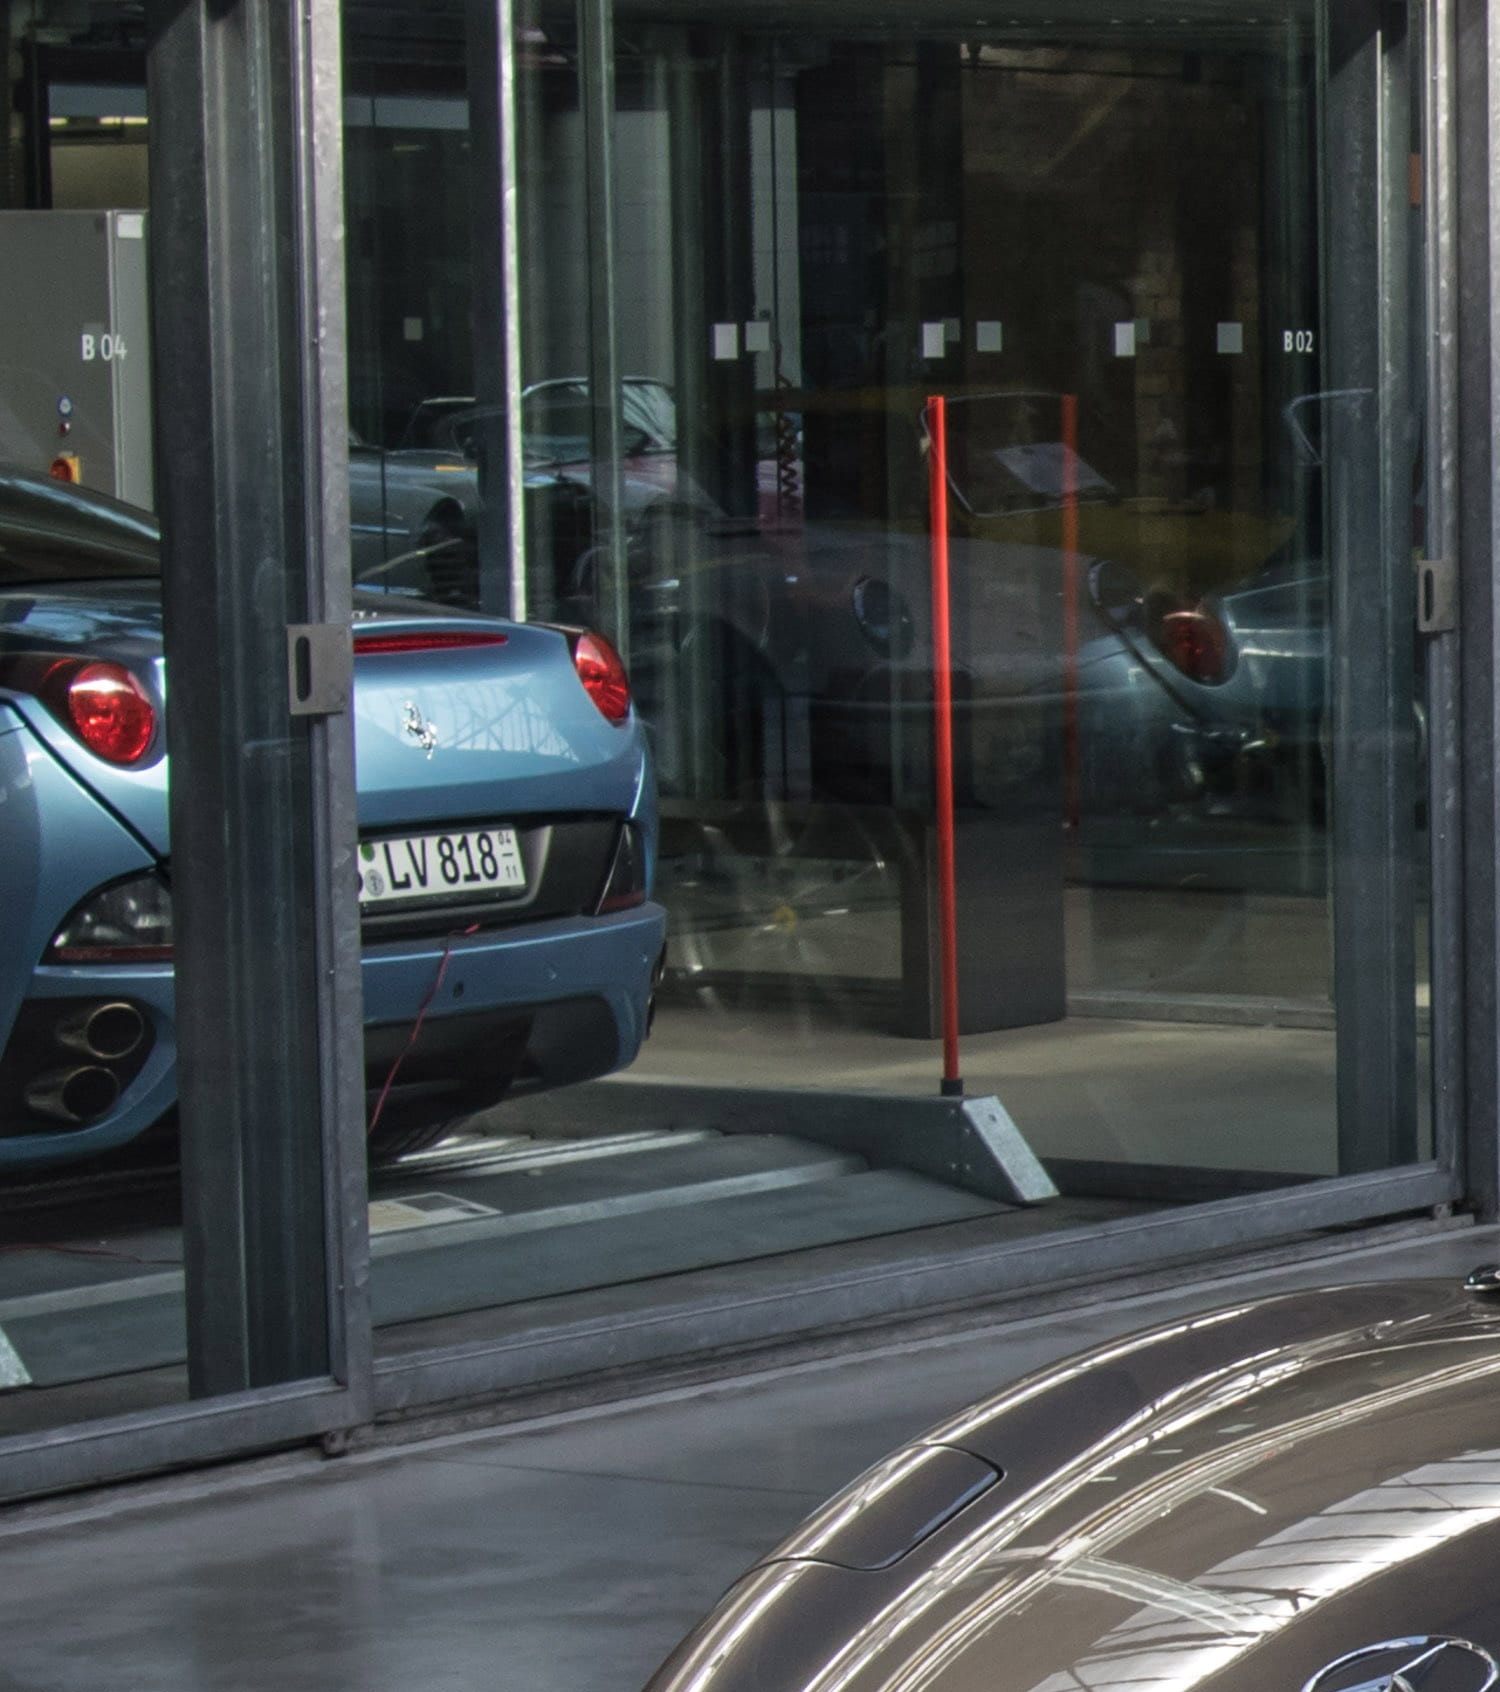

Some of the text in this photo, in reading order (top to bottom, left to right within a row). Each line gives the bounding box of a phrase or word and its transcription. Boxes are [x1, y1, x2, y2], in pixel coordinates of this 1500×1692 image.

[81, 333, 128, 361] B 04
[1283, 330, 1314, 352] B 02
[384, 832, 499, 890] LV 818
